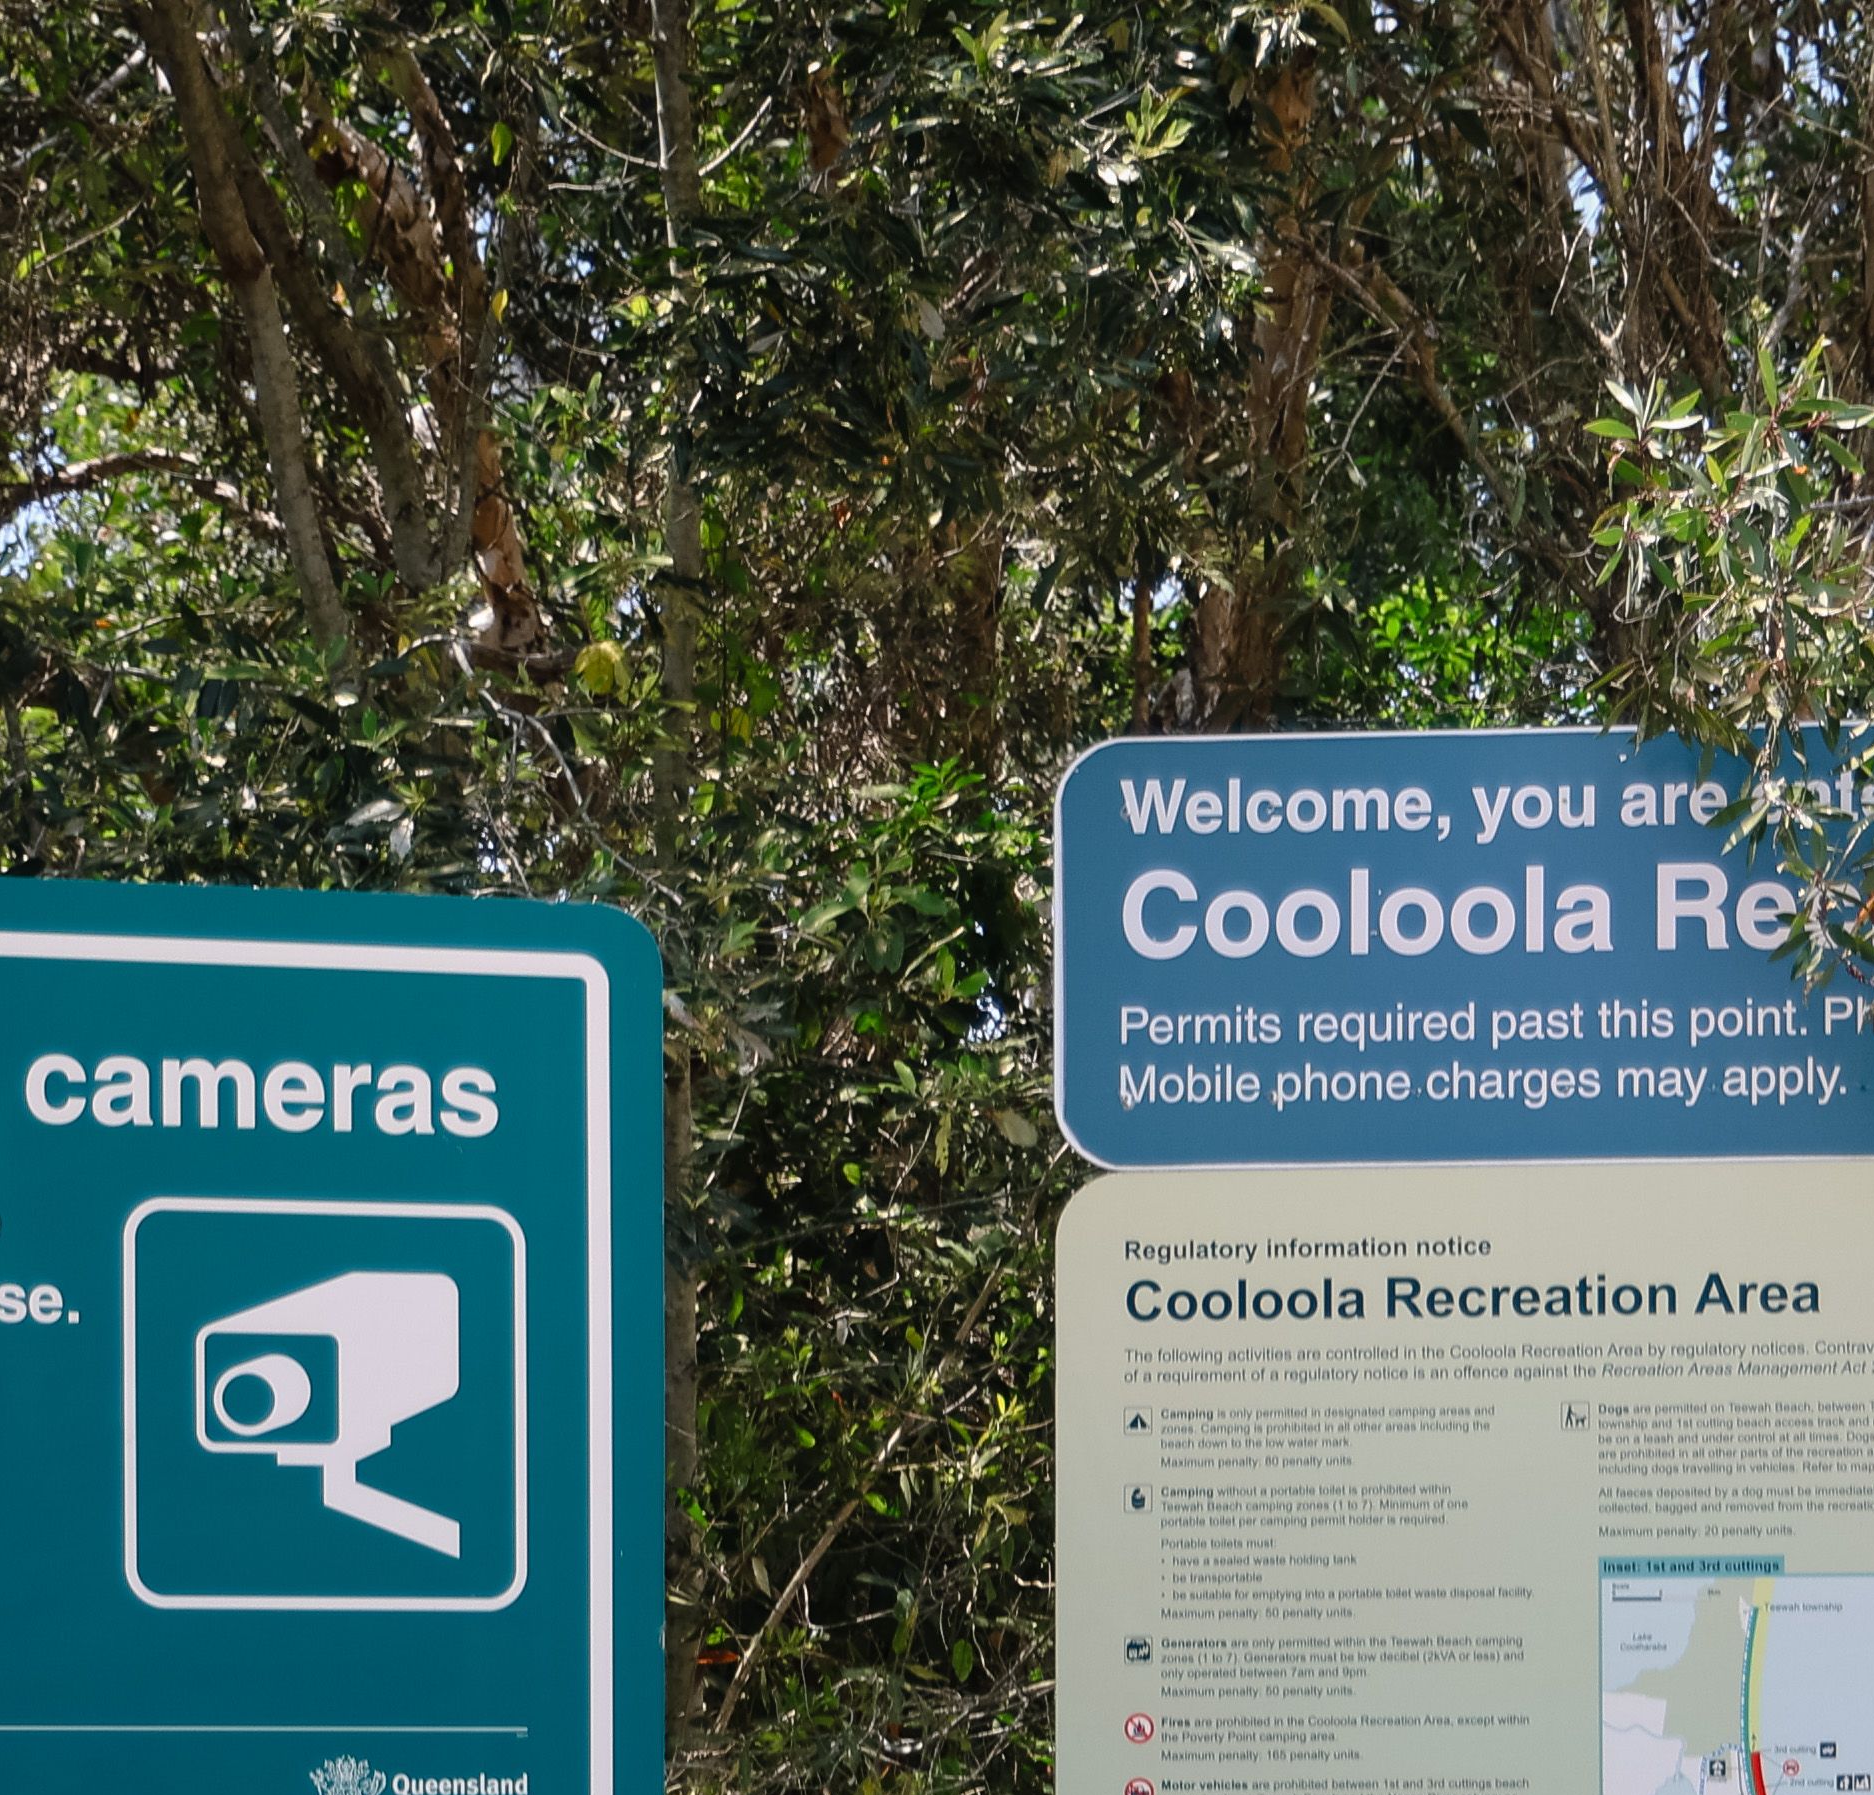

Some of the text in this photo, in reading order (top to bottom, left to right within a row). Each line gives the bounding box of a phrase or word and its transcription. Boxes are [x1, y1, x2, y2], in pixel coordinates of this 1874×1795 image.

[1120, 777, 1449, 841] Welcome,
[1471, 784, 1594, 844] you
[1620, 782, 1727, 828] are
[1122, 864, 1612, 960] Cooloola
[1120, 1005, 1280, 1045] Permits
[1298, 1001, 1473, 1052] required
[1492, 1002, 1582, 1050] past
[1597, 999, 1672, 1038] this
[1690, 990, 1806, 1047] point.
[26, 1053, 498, 1137] cameras
[1120, 1056, 1846, 1112] Mobile phone charges may apply.
[1126, 1236, 1490, 1264] Regulatory information notice
[1127, 1273, 1819, 1322] Cooloola Recreation Area
[1124, 1368, 1138, 1383] of
[1143, 1372, 1151, 1382] a
[1157, 1366, 1245, 1386] requirement
[1251, 1367, 1265, 1381] of
[1270, 1371, 1278, 1381] a
[1285, 1366, 1358, 1384] regulatory
[1364, 1365, 1408, 1380] notice
[1414, 1367, 1424, 1379] is
[1431, 1368, 1448, 1379] an
[1454, 1365, 1508, 1379] offence
[1514, 1364, 1567, 1381] against
[1574, 1363, 1596, 1377] the
[1602, 1361, 1683, 1377] Recreation
[1687, 1361, 1731, 1376] Areas
[1738, 1361, 1837, 1378] Management
[1841, 1360, 1866, 1374] Act
[1126, 1348, 1152, 1363] The
[1158, 1348, 1222, 1364] following
[1228, 1347, 1291, 1362] activities
[1297, 1349, 1320, 1361] are
[1326, 1345, 1398, 1360] controlled
[1404, 1346, 1416, 1360] in
[1422, 1345, 1444, 1359] the
[1450, 1344, 1516, 1359] Cooloola
[1522, 1343, 1602, 1358] Recreation
[1608, 1343, 1642, 1357] Area
[1649, 1343, 1665, 1360] by
[1671, 1342, 1746, 1363] regulatory
[1752, 1341, 1808, 1355] notices.
